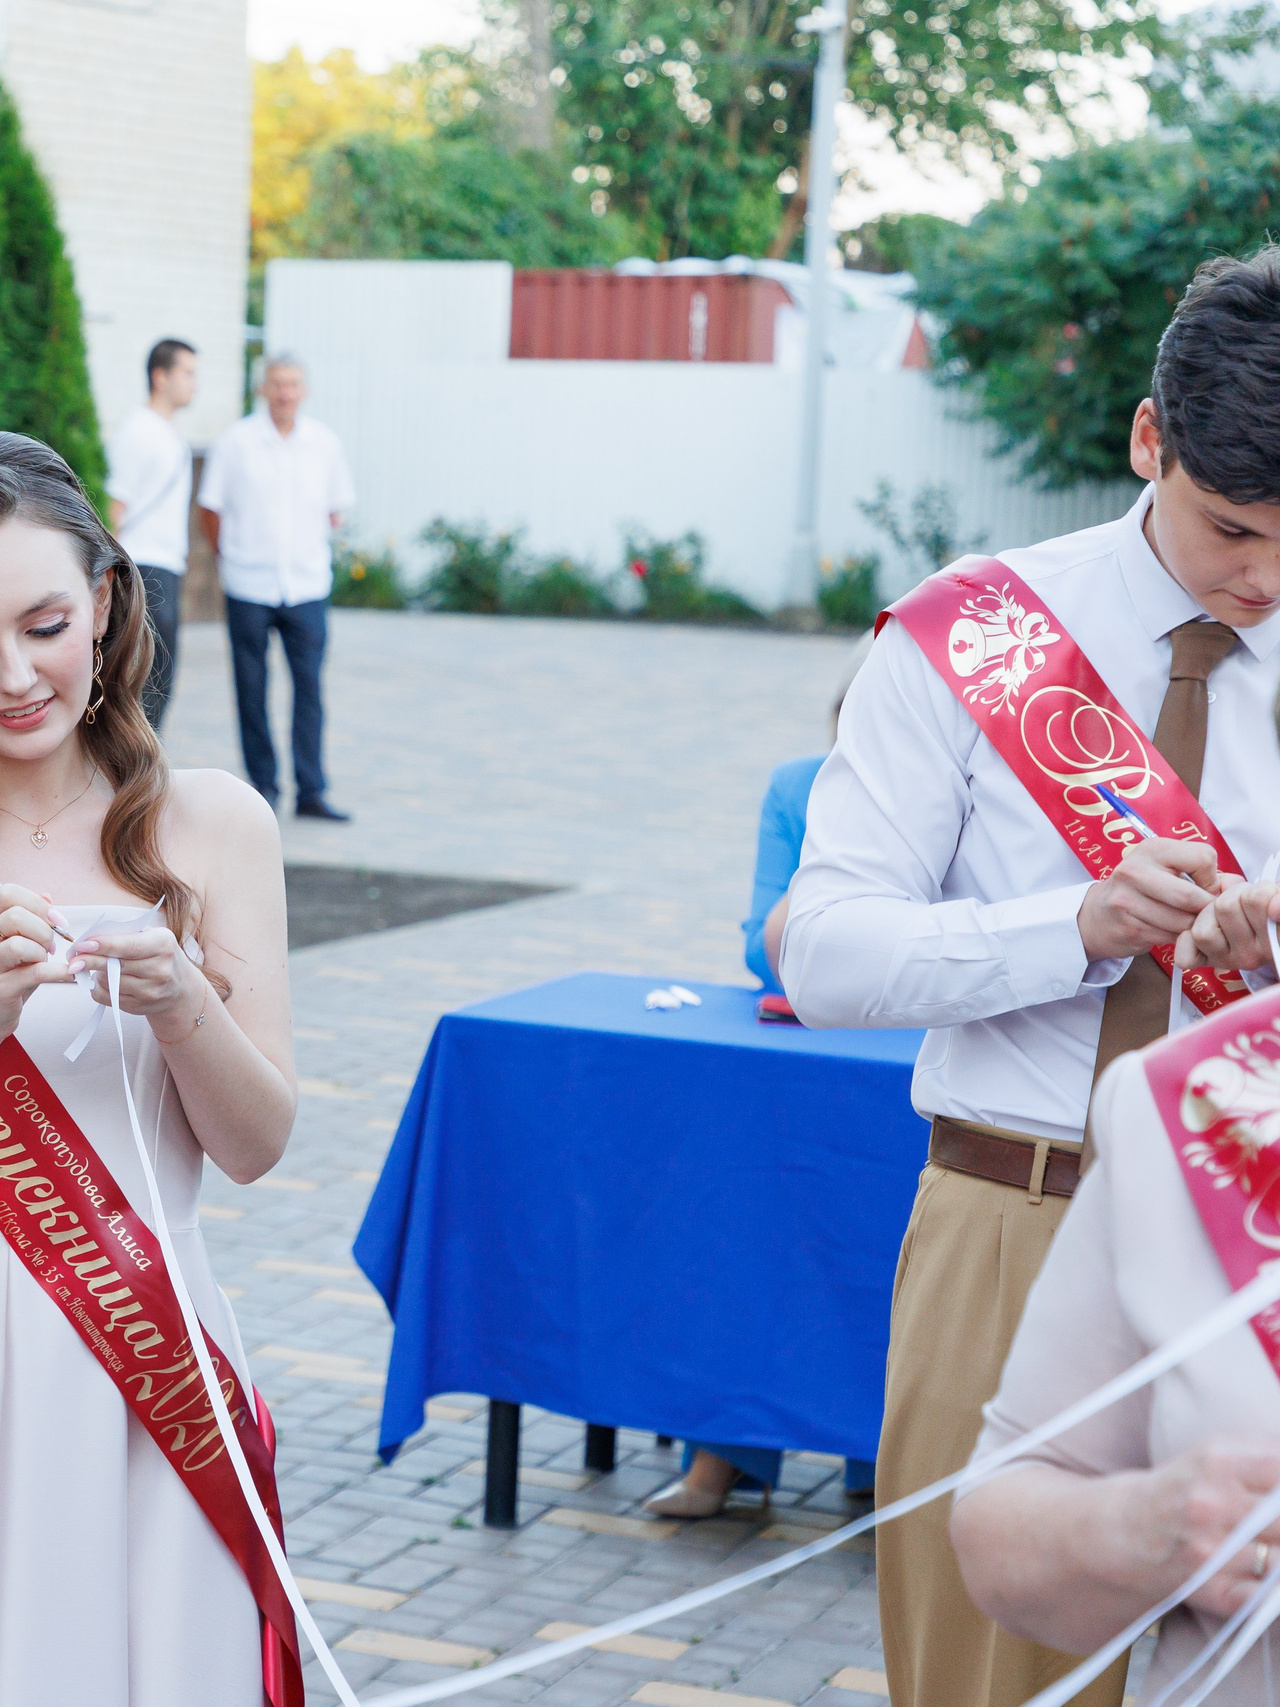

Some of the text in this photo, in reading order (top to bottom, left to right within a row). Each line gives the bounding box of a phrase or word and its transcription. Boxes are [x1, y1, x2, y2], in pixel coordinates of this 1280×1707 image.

[1064, 819, 1085, 837] 11
[1200, 992, 1223, 1009] 35
[4, 1074, 153, 1272] Сорокопудова Алиса
[40, 1266, 64, 1284] 35
[55, 1286, 71, 1302] ст.
[66, 1297, 125, 1373] Новотитаровская
